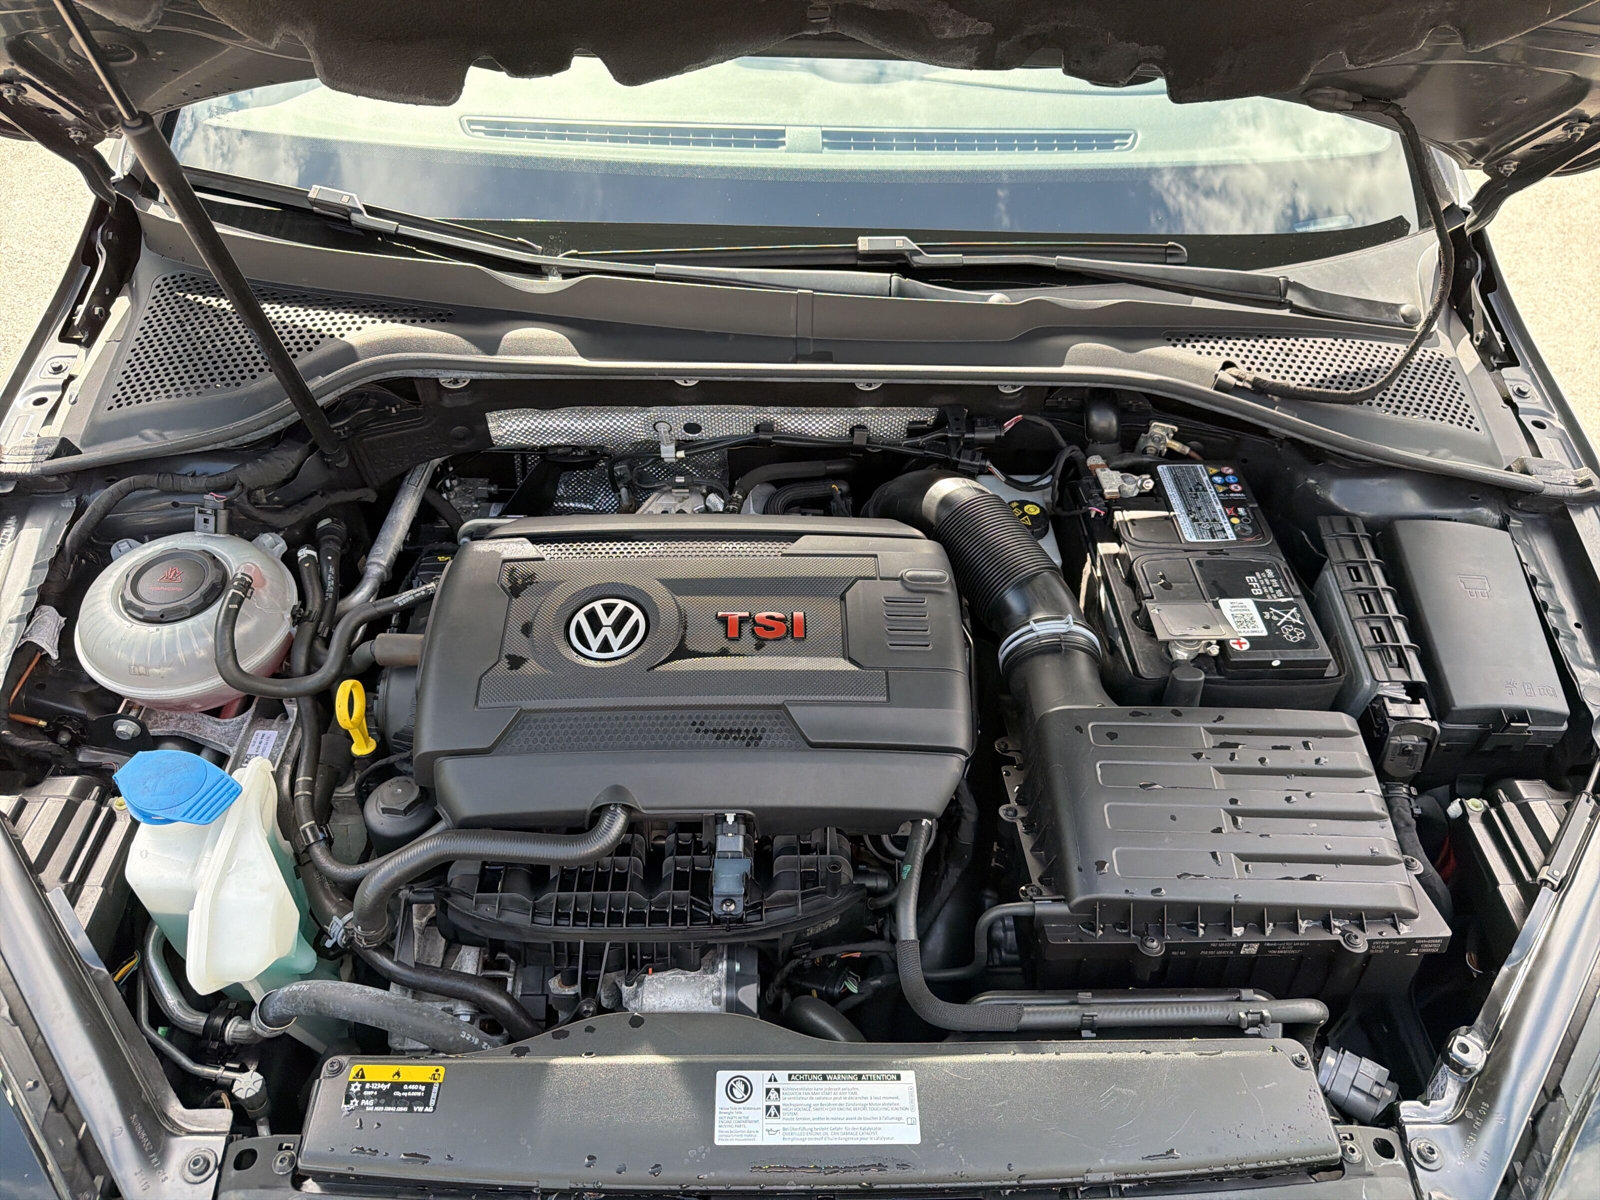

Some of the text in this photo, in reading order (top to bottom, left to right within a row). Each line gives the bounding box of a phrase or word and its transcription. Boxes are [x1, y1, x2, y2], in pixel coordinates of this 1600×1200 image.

[1245, 576, 1263, 595] EFB
[717, 611, 805, 639] TSI
[365, 1083, 391, 1091] R-1234yf
